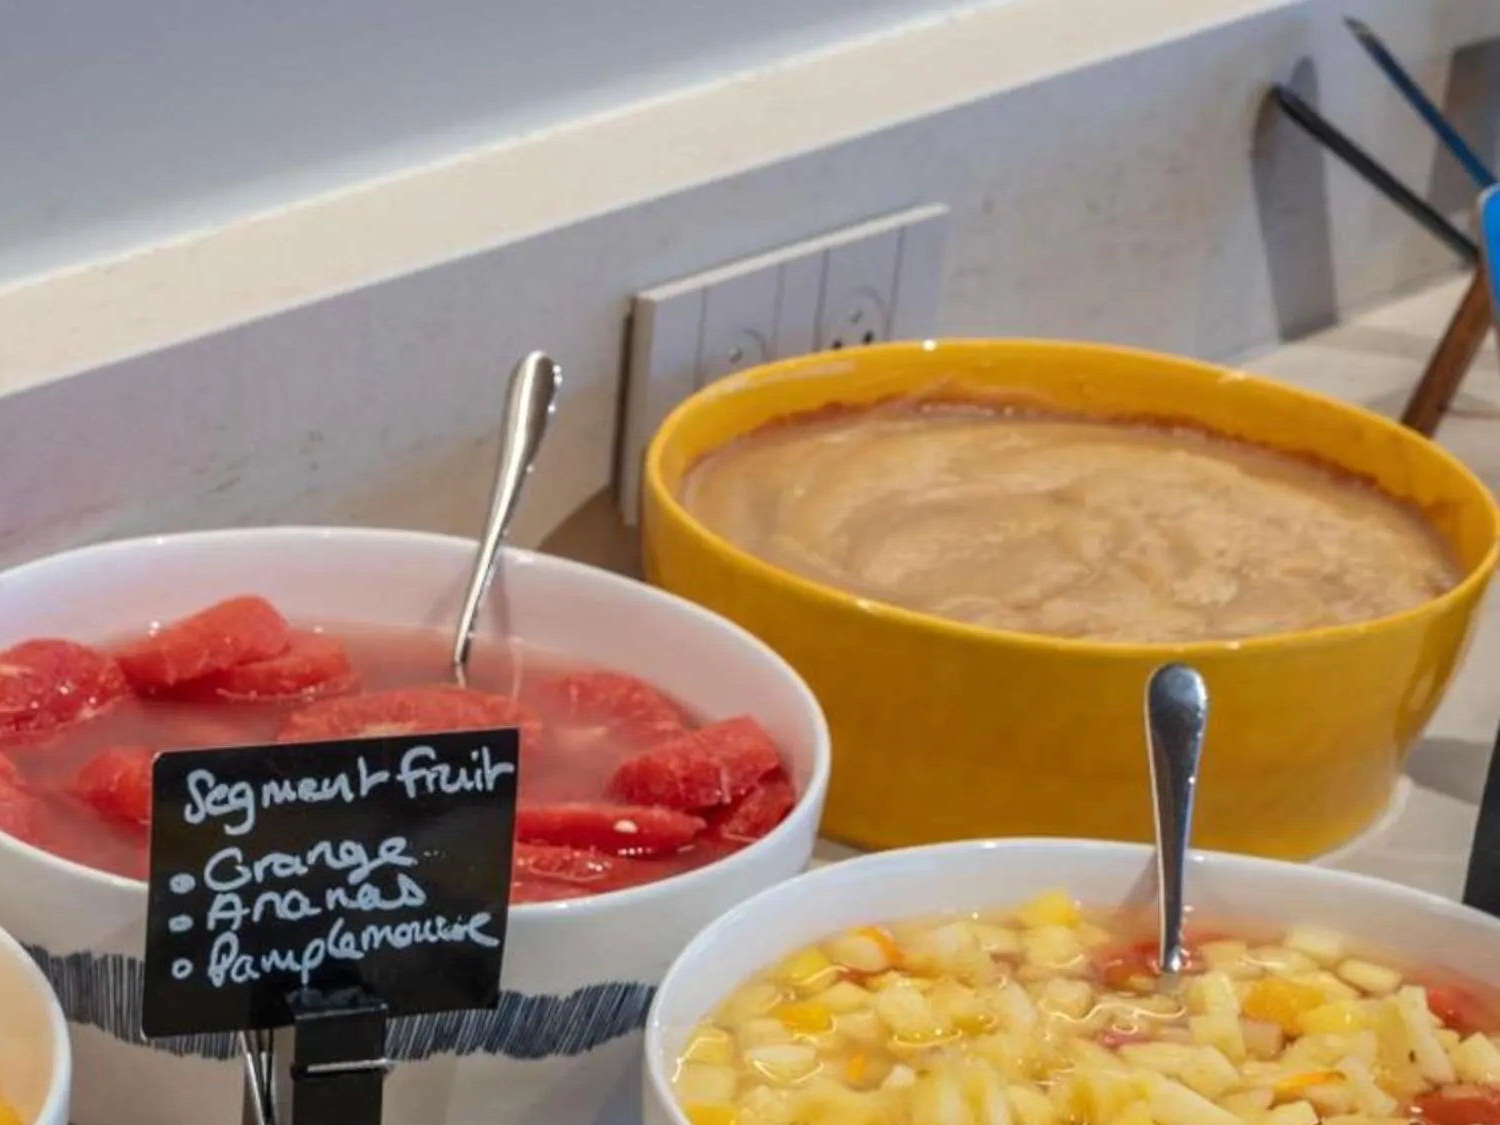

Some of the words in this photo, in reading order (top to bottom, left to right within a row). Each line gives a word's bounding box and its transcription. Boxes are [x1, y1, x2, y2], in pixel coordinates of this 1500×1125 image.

[184, 756, 390, 835] Segment
[204, 836, 416, 891] Orange
[207, 874, 426, 931] Ananas
